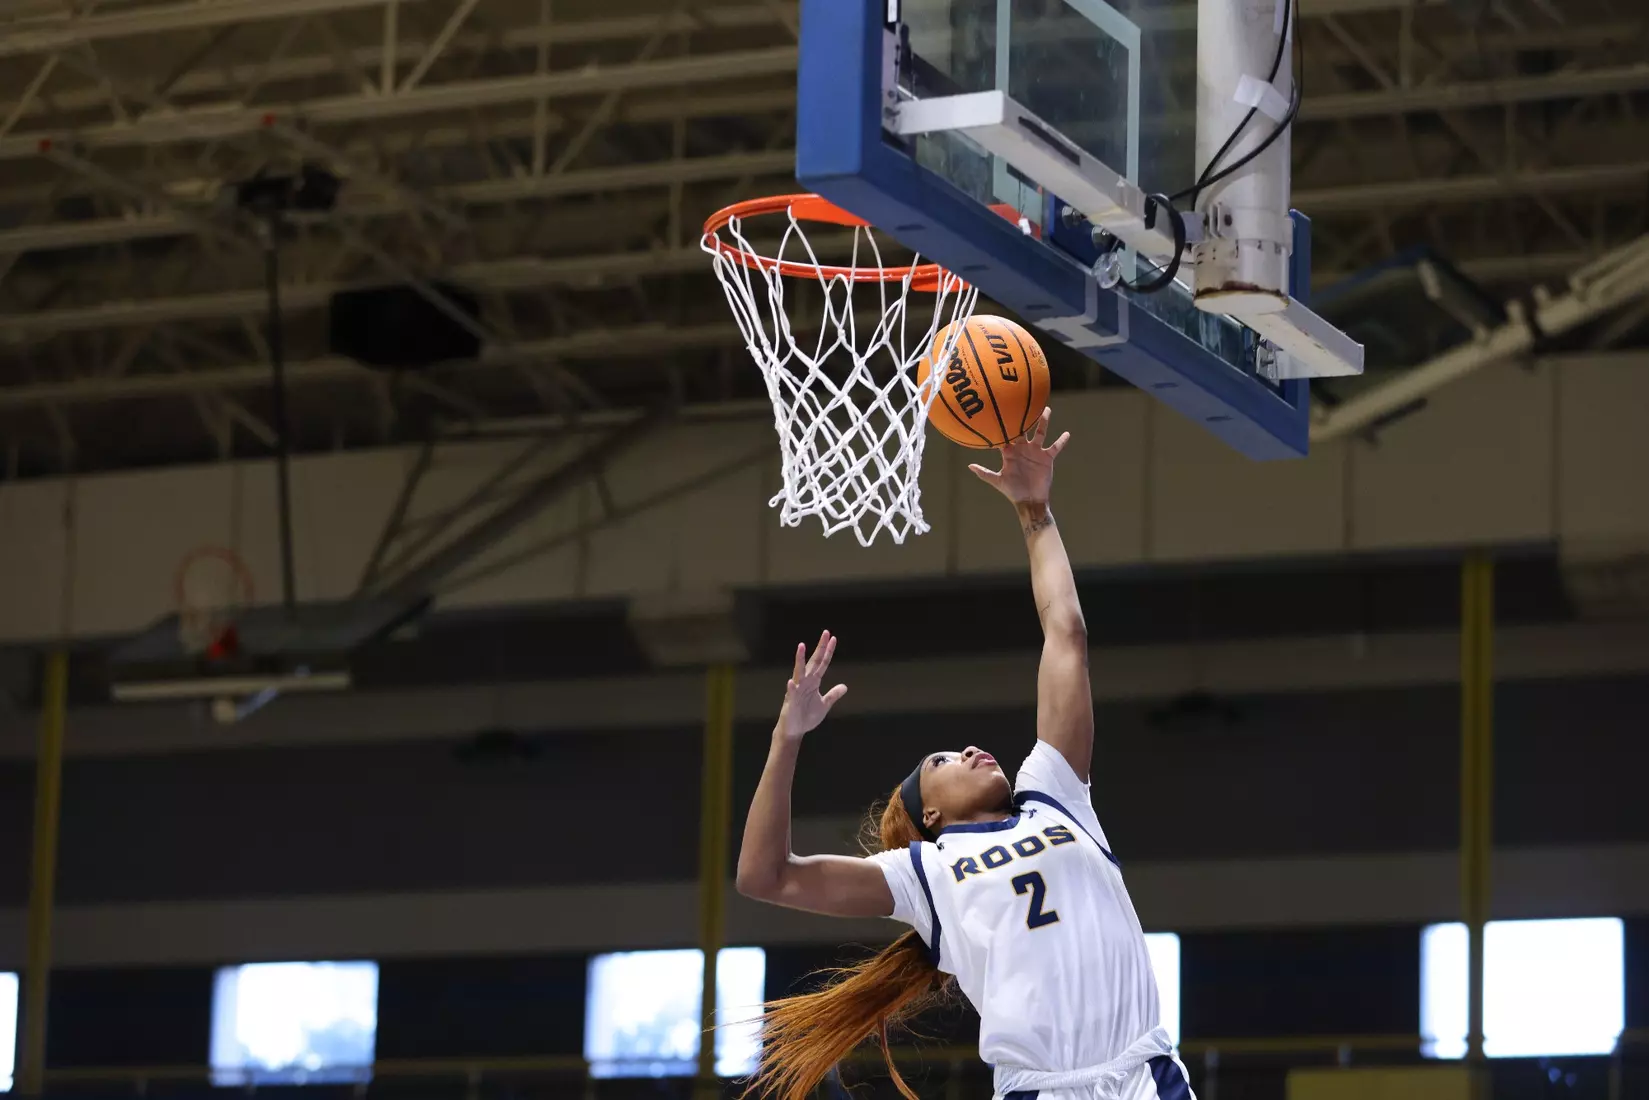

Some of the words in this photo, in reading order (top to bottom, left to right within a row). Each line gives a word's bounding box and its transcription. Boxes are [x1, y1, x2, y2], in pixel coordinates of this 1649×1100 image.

[986, 334, 1018, 382] EVO
[949, 825, 1076, 883] ROOS
[1011, 871, 1060, 930] 2
